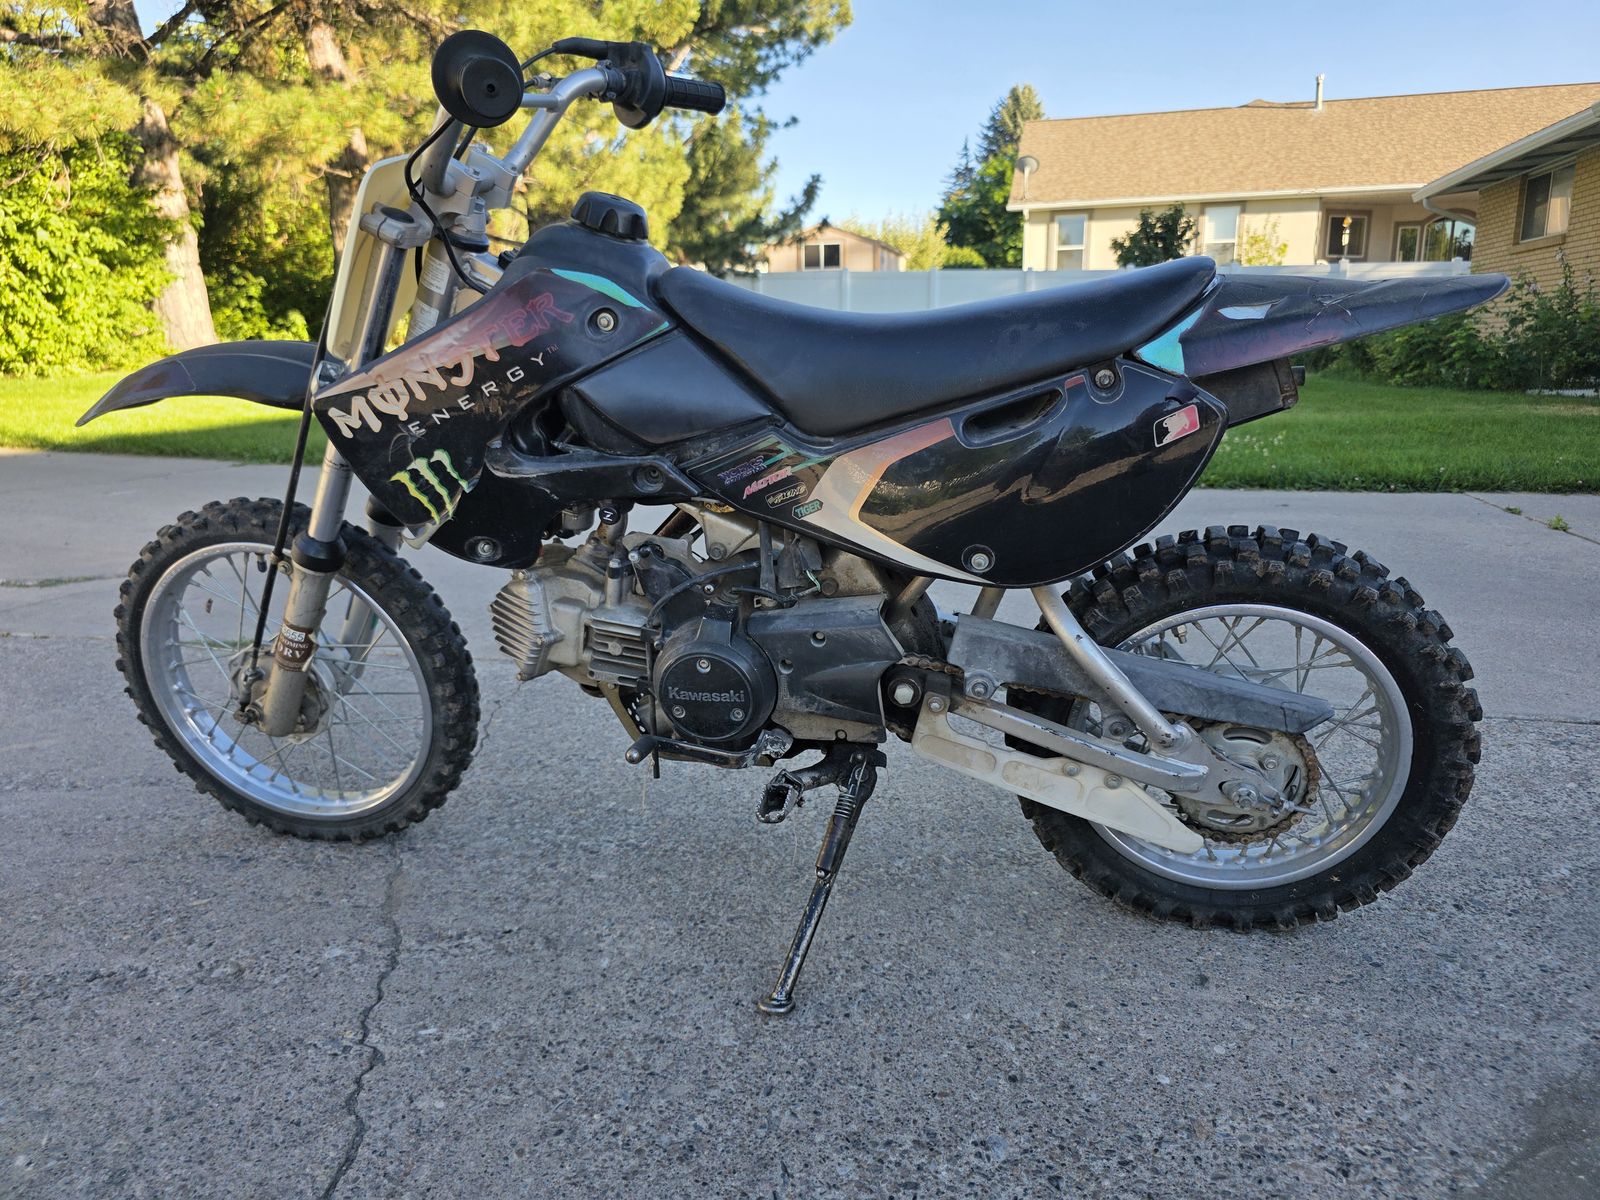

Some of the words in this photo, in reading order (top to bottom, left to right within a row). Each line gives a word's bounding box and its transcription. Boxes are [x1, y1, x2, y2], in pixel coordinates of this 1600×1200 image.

[328, 293, 574, 438] MONSTER
[407, 351, 545, 436] ENERGY
[795, 501, 820, 517] TIGER
[668, 686, 745, 702] Kawasaki
